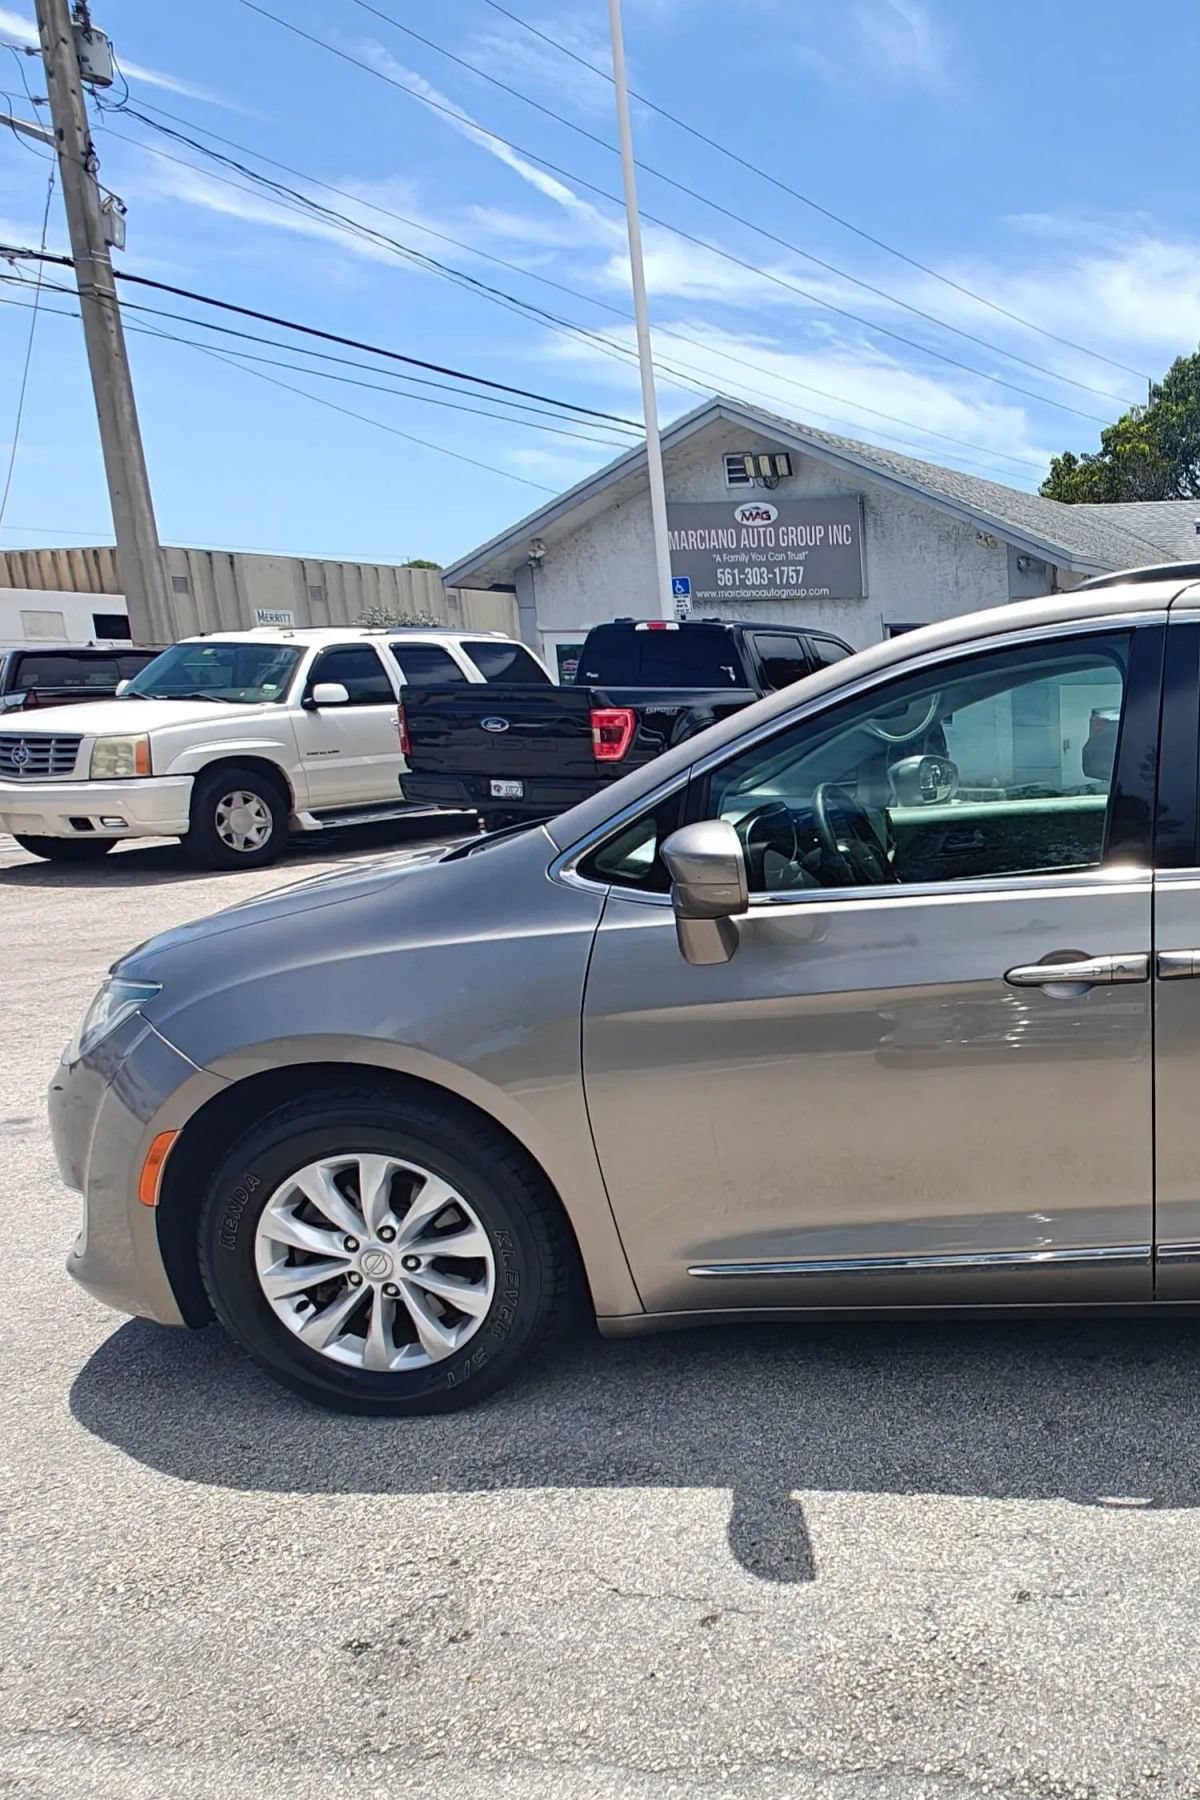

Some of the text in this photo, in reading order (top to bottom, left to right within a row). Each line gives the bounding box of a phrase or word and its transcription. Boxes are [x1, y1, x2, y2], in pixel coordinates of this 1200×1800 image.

[740, 510, 771, 522] MAG
[668, 523, 852, 551] MARCIANO AUTO GROUP INC
[723, 552, 749, 564] Family
[750, 552, 766, 562] You
[768, 551, 786, 561] Can
[787, 550, 809, 561] Trust"
[717, 566, 805, 586] 561-303-1757
[696, 587, 830, 599] www.marcianoautogroup.com
[256, 609, 292, 624] MERRITT
[218, 1173, 261, 1250] KENDA
